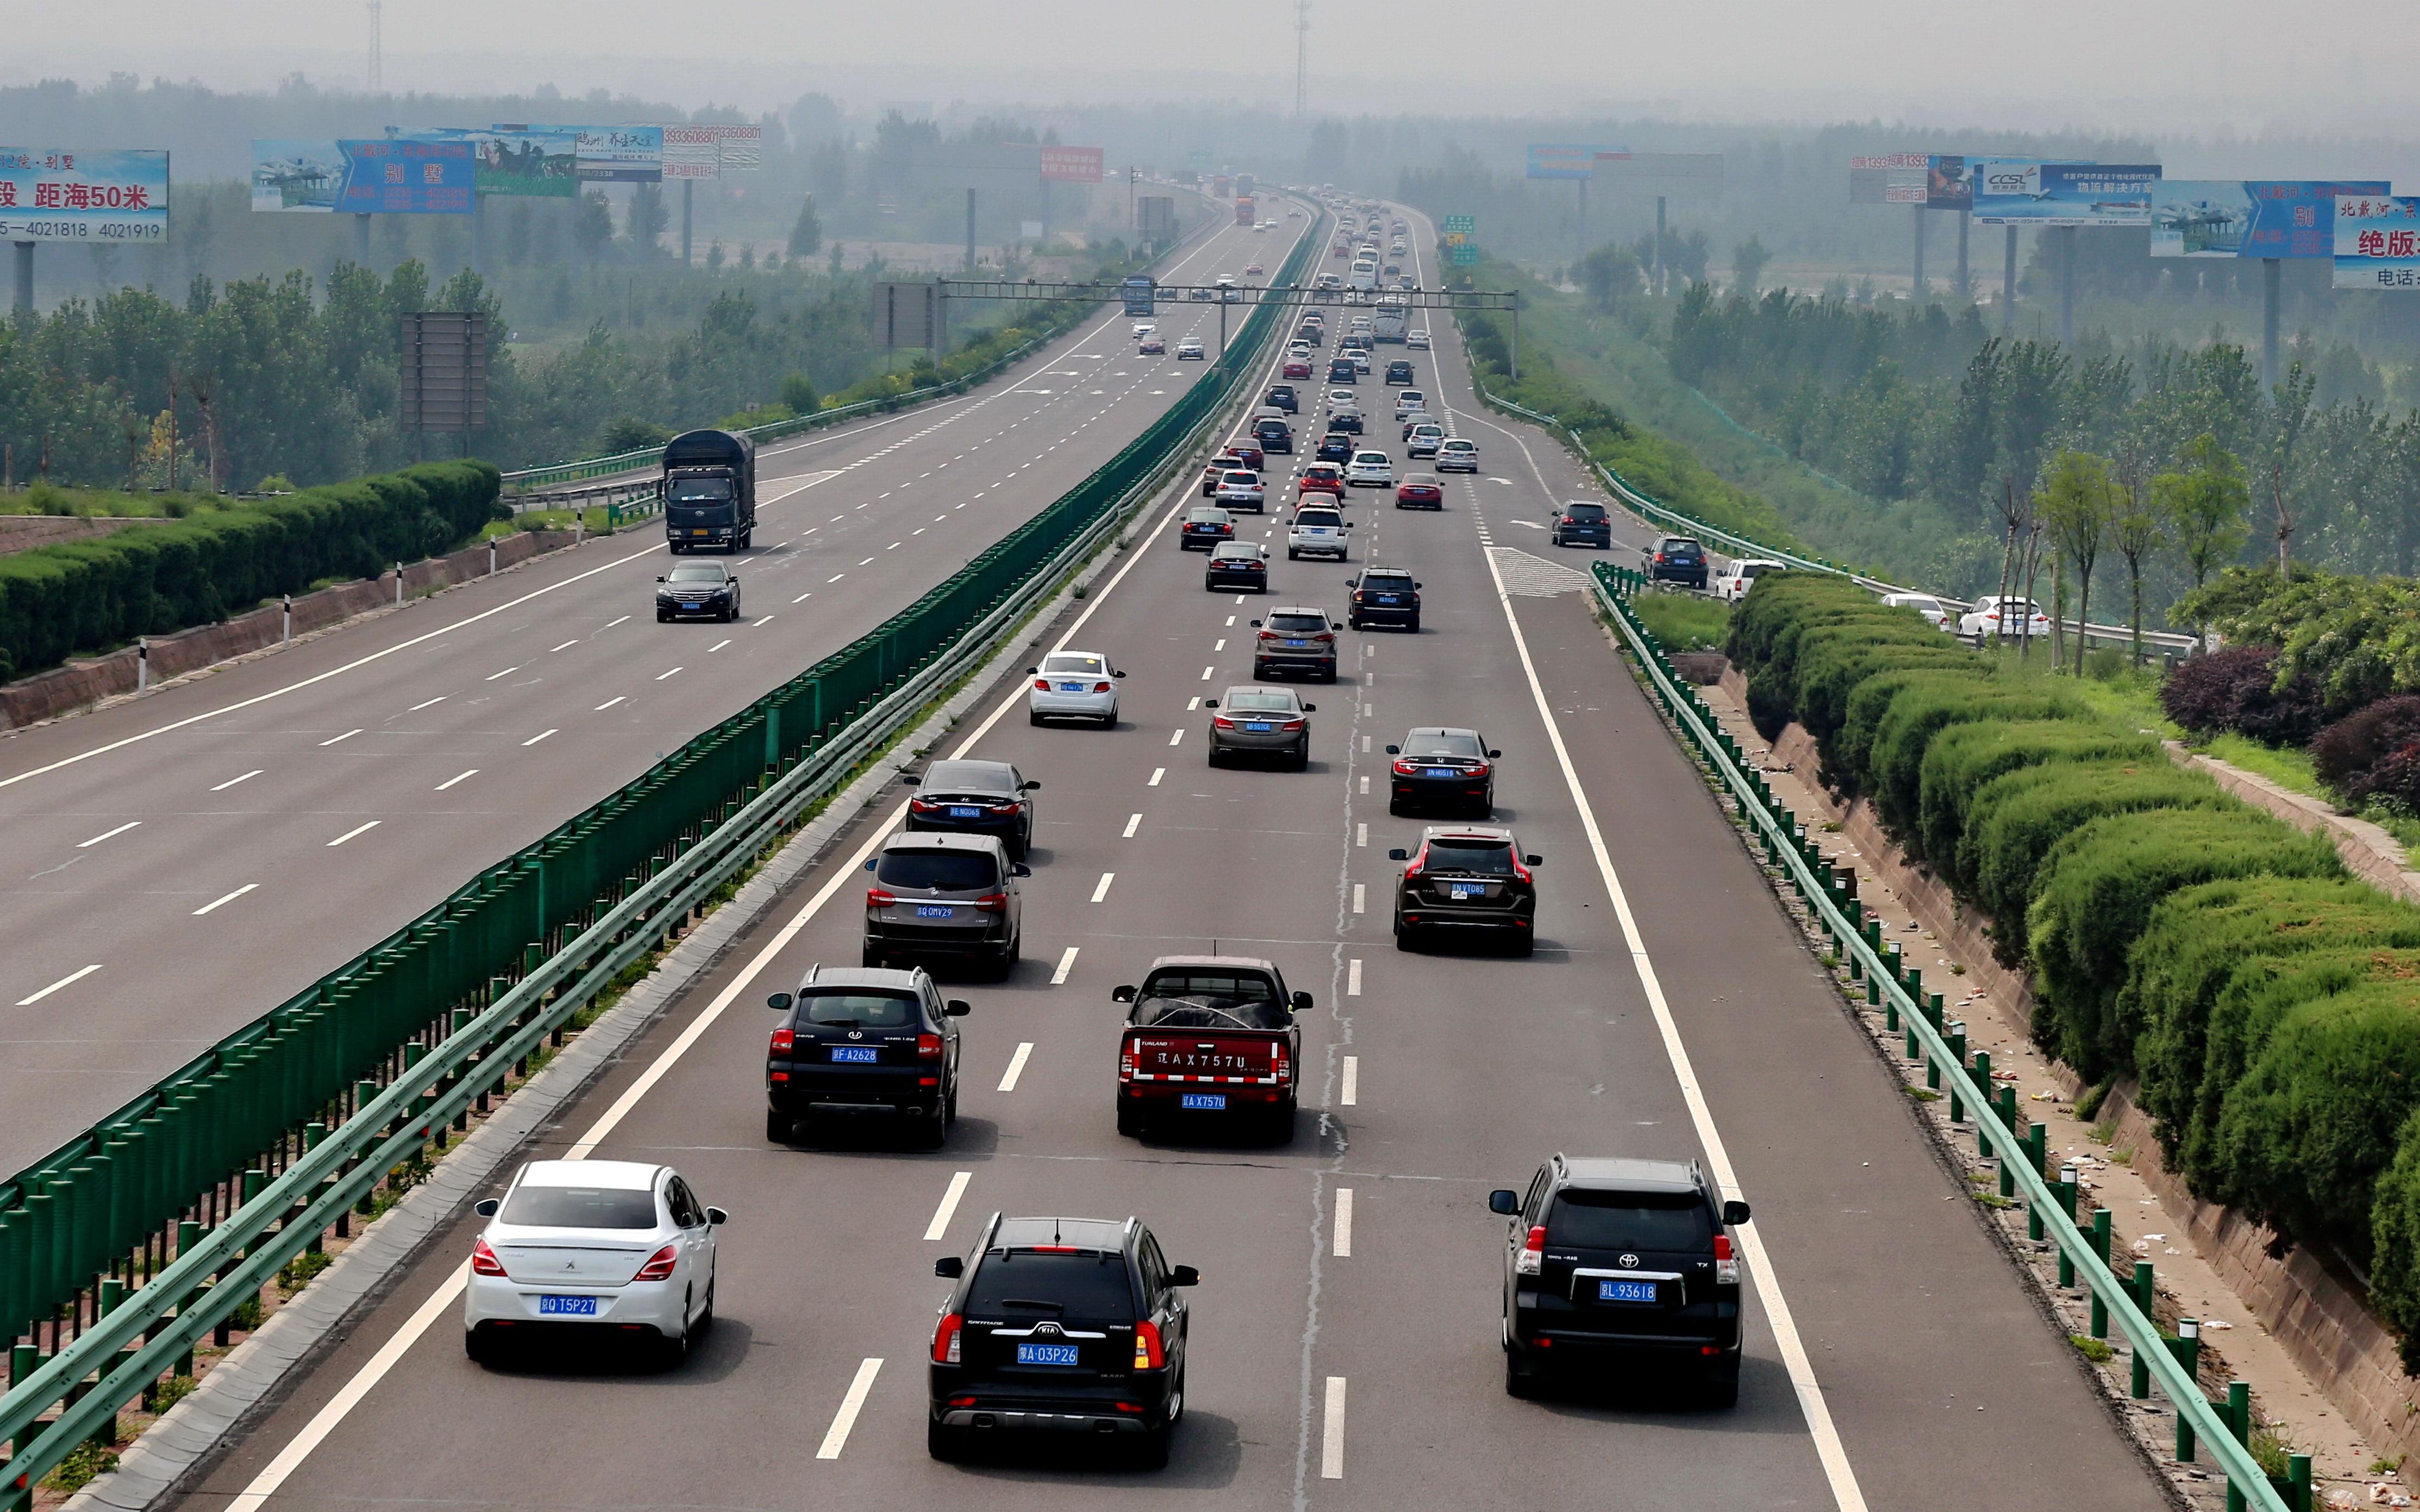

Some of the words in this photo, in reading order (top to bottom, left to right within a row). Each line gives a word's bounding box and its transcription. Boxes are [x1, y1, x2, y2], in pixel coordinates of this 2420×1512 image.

[1988, 174, 2027, 184] CCSL
[35, 182, 149, 211] 距海50米
[99, 224, 160, 239] 4021919
[2358, 229, 2420, 258] 绝版
[1041, 1326, 1056, 1334] KIA
